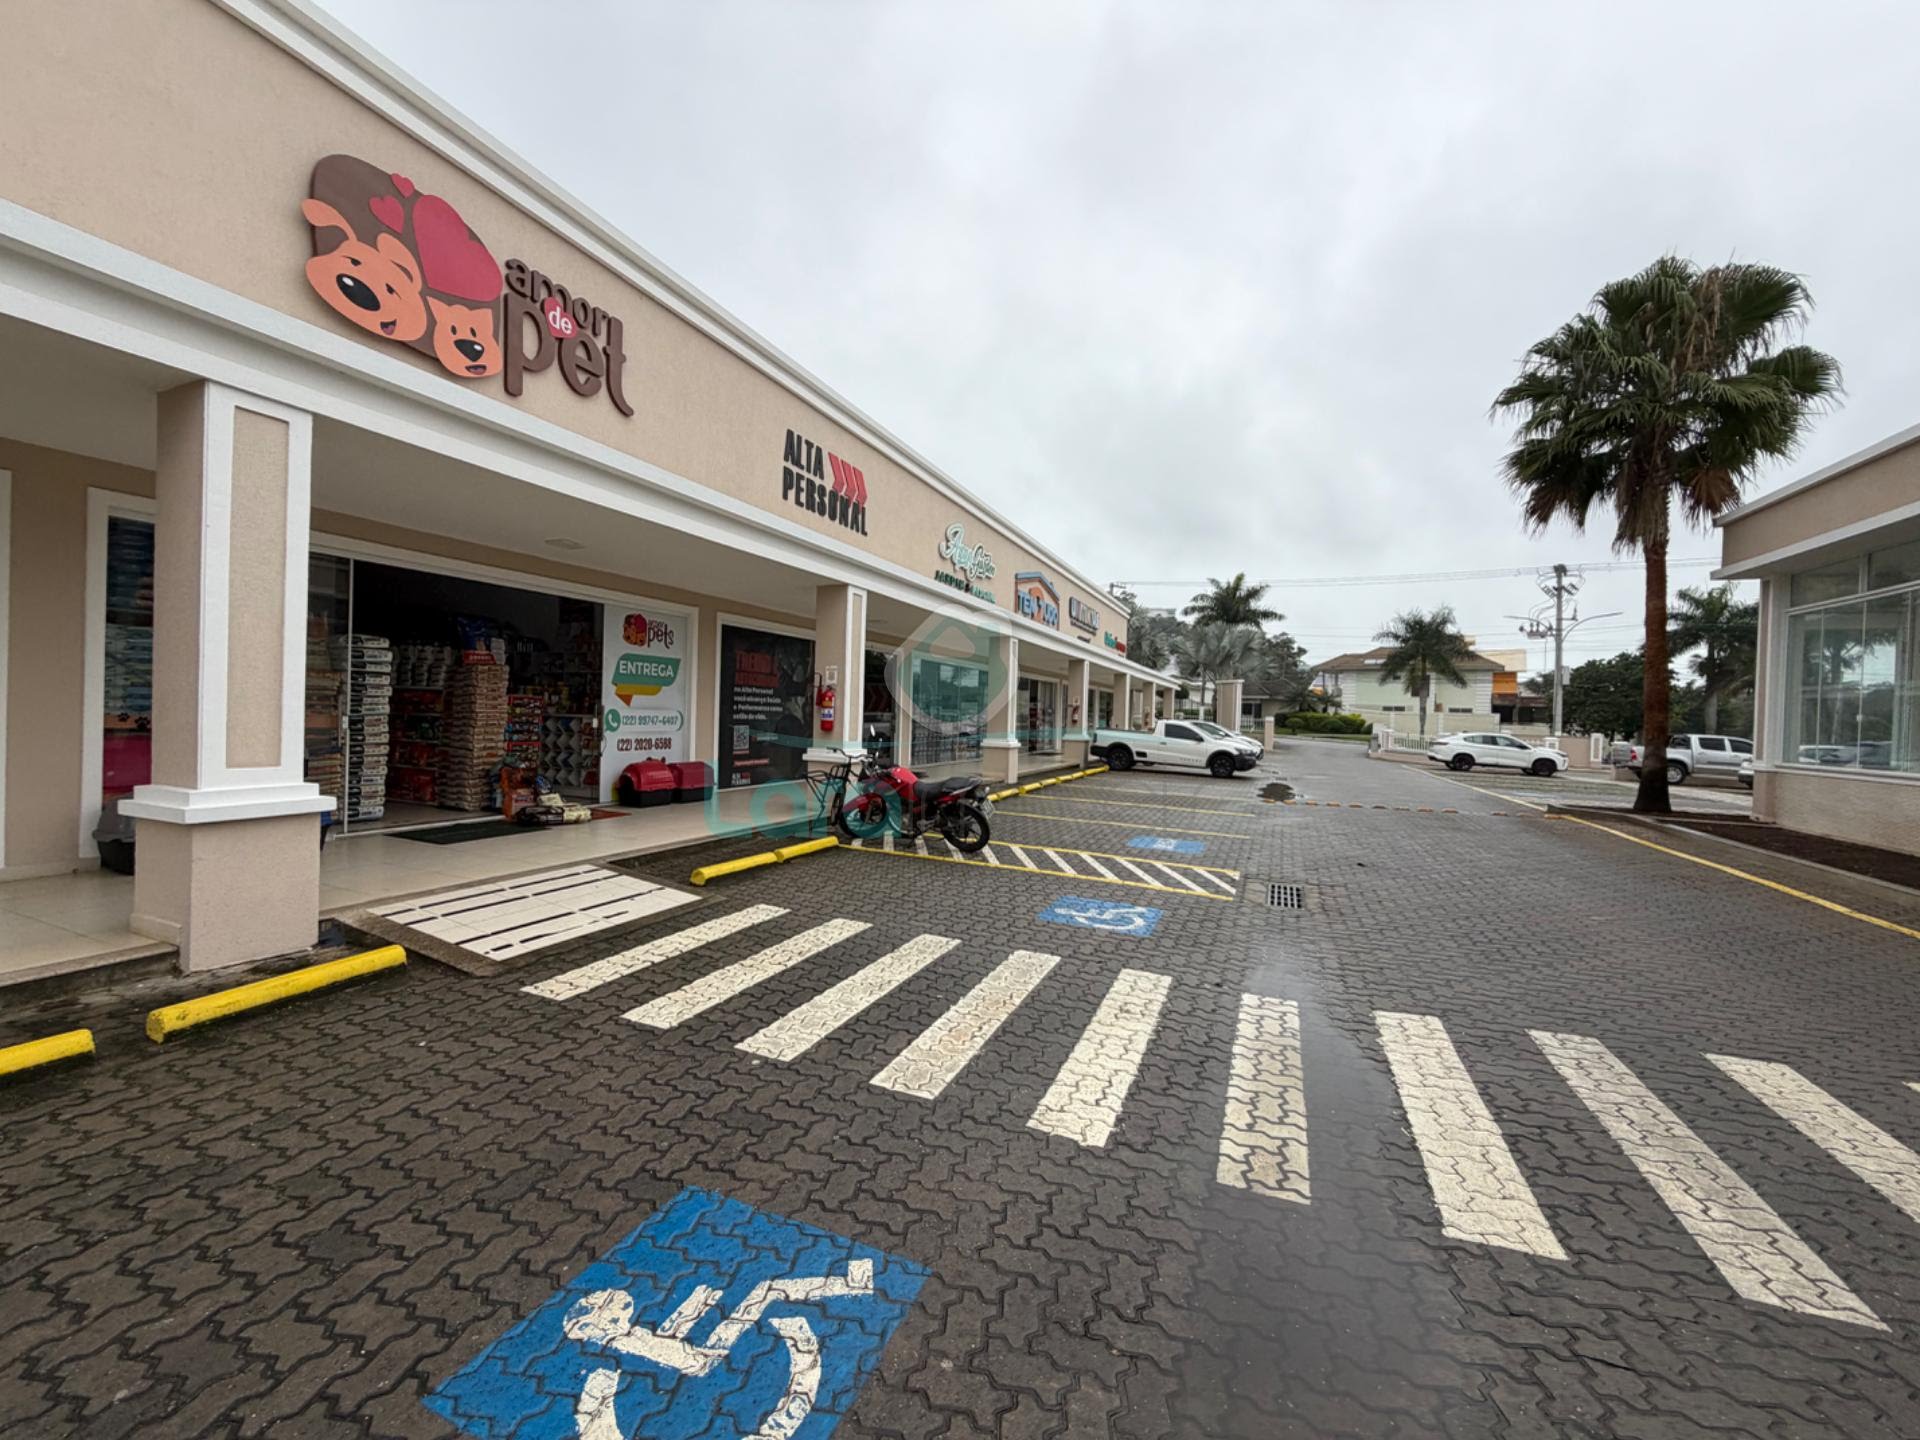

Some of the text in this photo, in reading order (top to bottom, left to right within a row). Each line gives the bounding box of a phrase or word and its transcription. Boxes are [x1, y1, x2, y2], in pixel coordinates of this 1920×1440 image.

[505, 258, 610, 338] amor
[548, 306, 573, 335] de
[503, 293, 634, 417] pet
[783, 428, 825, 481] ALTA
[782, 465, 868, 537] PERSONAL
[647, 623, 675, 650] pets
[619, 660, 674, 678] ENTREGA
[617, 738, 633, 752] (22)
